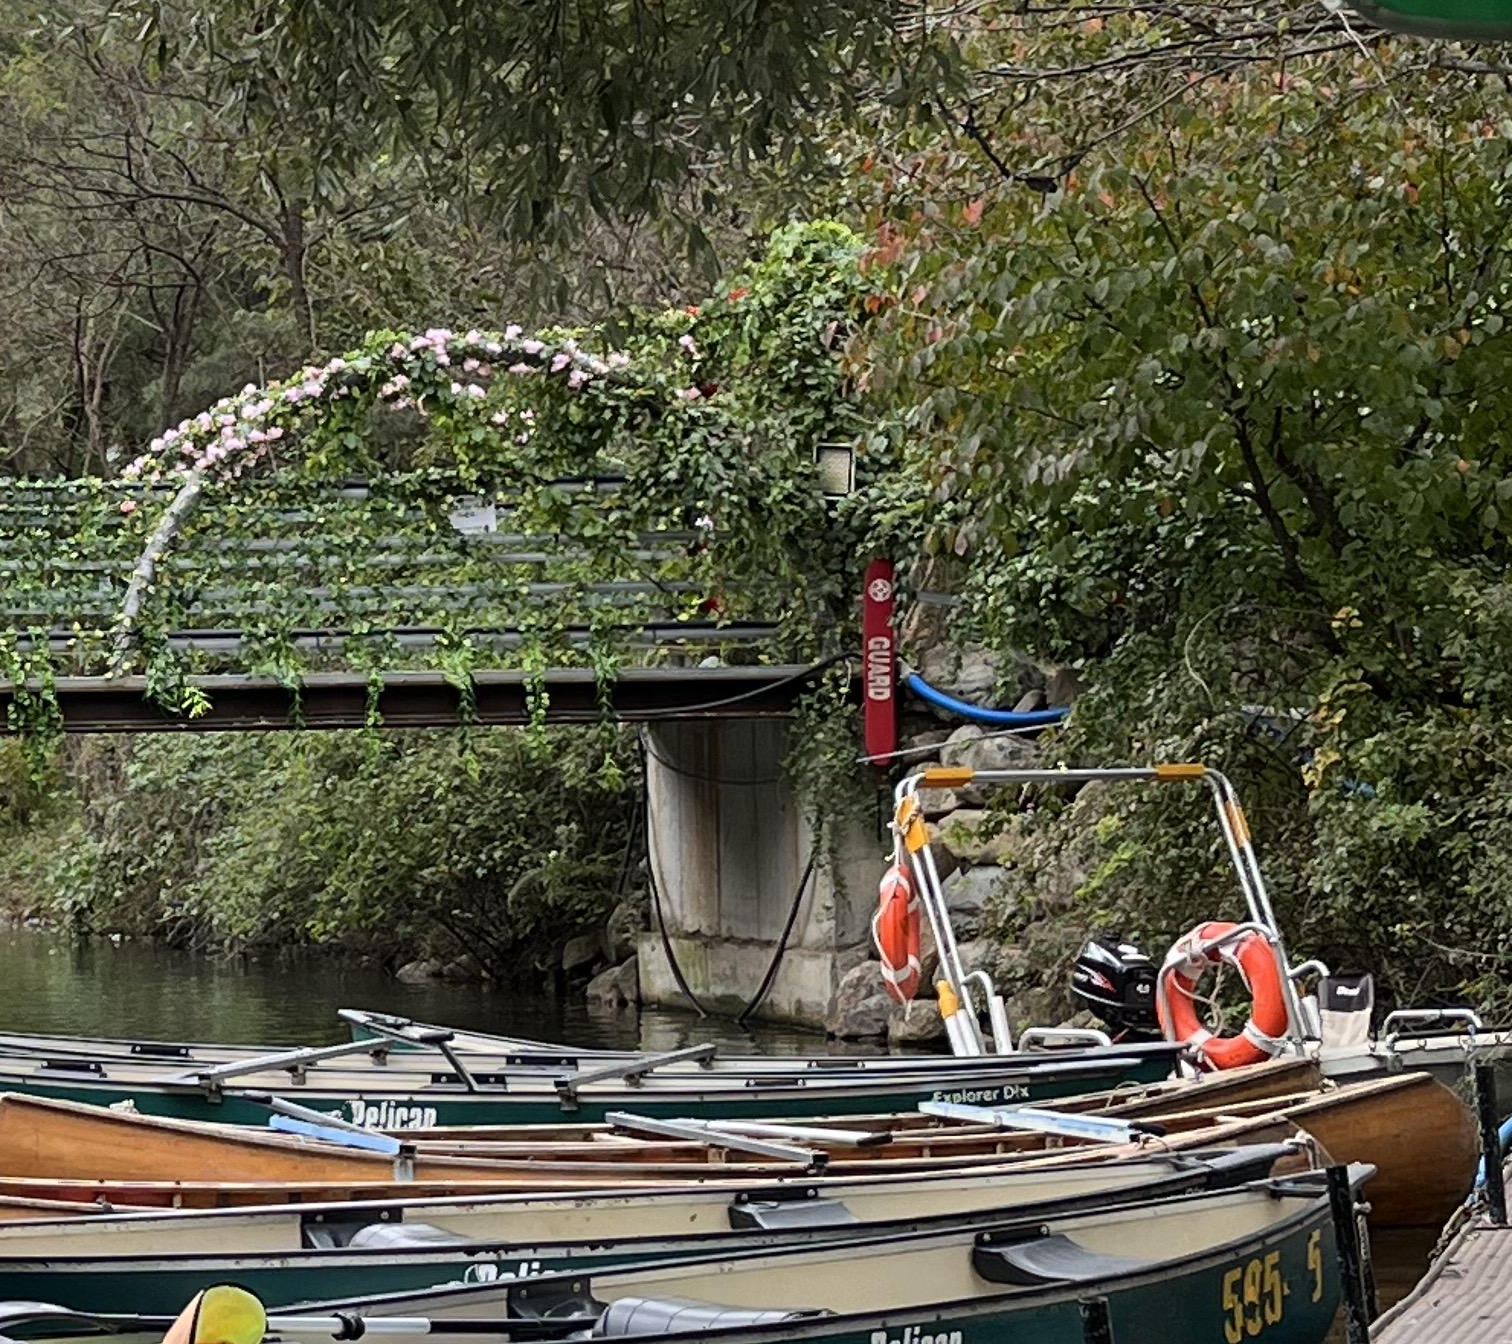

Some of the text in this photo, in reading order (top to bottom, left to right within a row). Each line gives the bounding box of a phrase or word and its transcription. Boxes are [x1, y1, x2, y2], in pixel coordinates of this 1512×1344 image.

[868, 636, 891, 701] GUARD
[932, 1089, 1000, 1105] Explorer
[350, 1100, 438, 1130] Pelican
